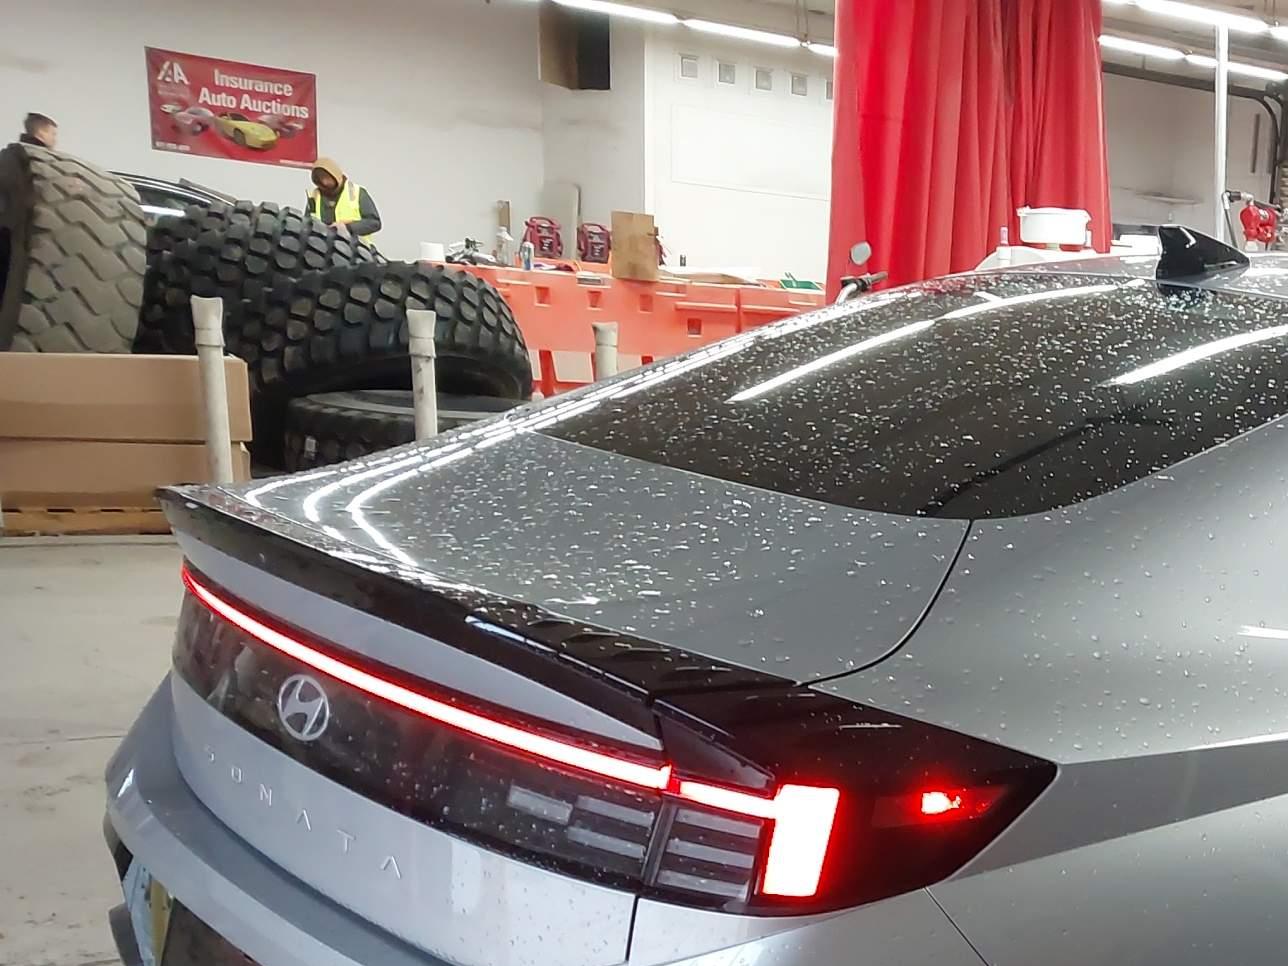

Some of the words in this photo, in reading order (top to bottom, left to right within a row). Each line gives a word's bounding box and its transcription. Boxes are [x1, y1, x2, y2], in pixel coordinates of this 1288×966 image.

[214, 68, 294, 97] Insurance
[198, 87, 237, 109] Auto
[240, 93, 310, 119] Auctions
[204, 745, 402, 880] SONATA
